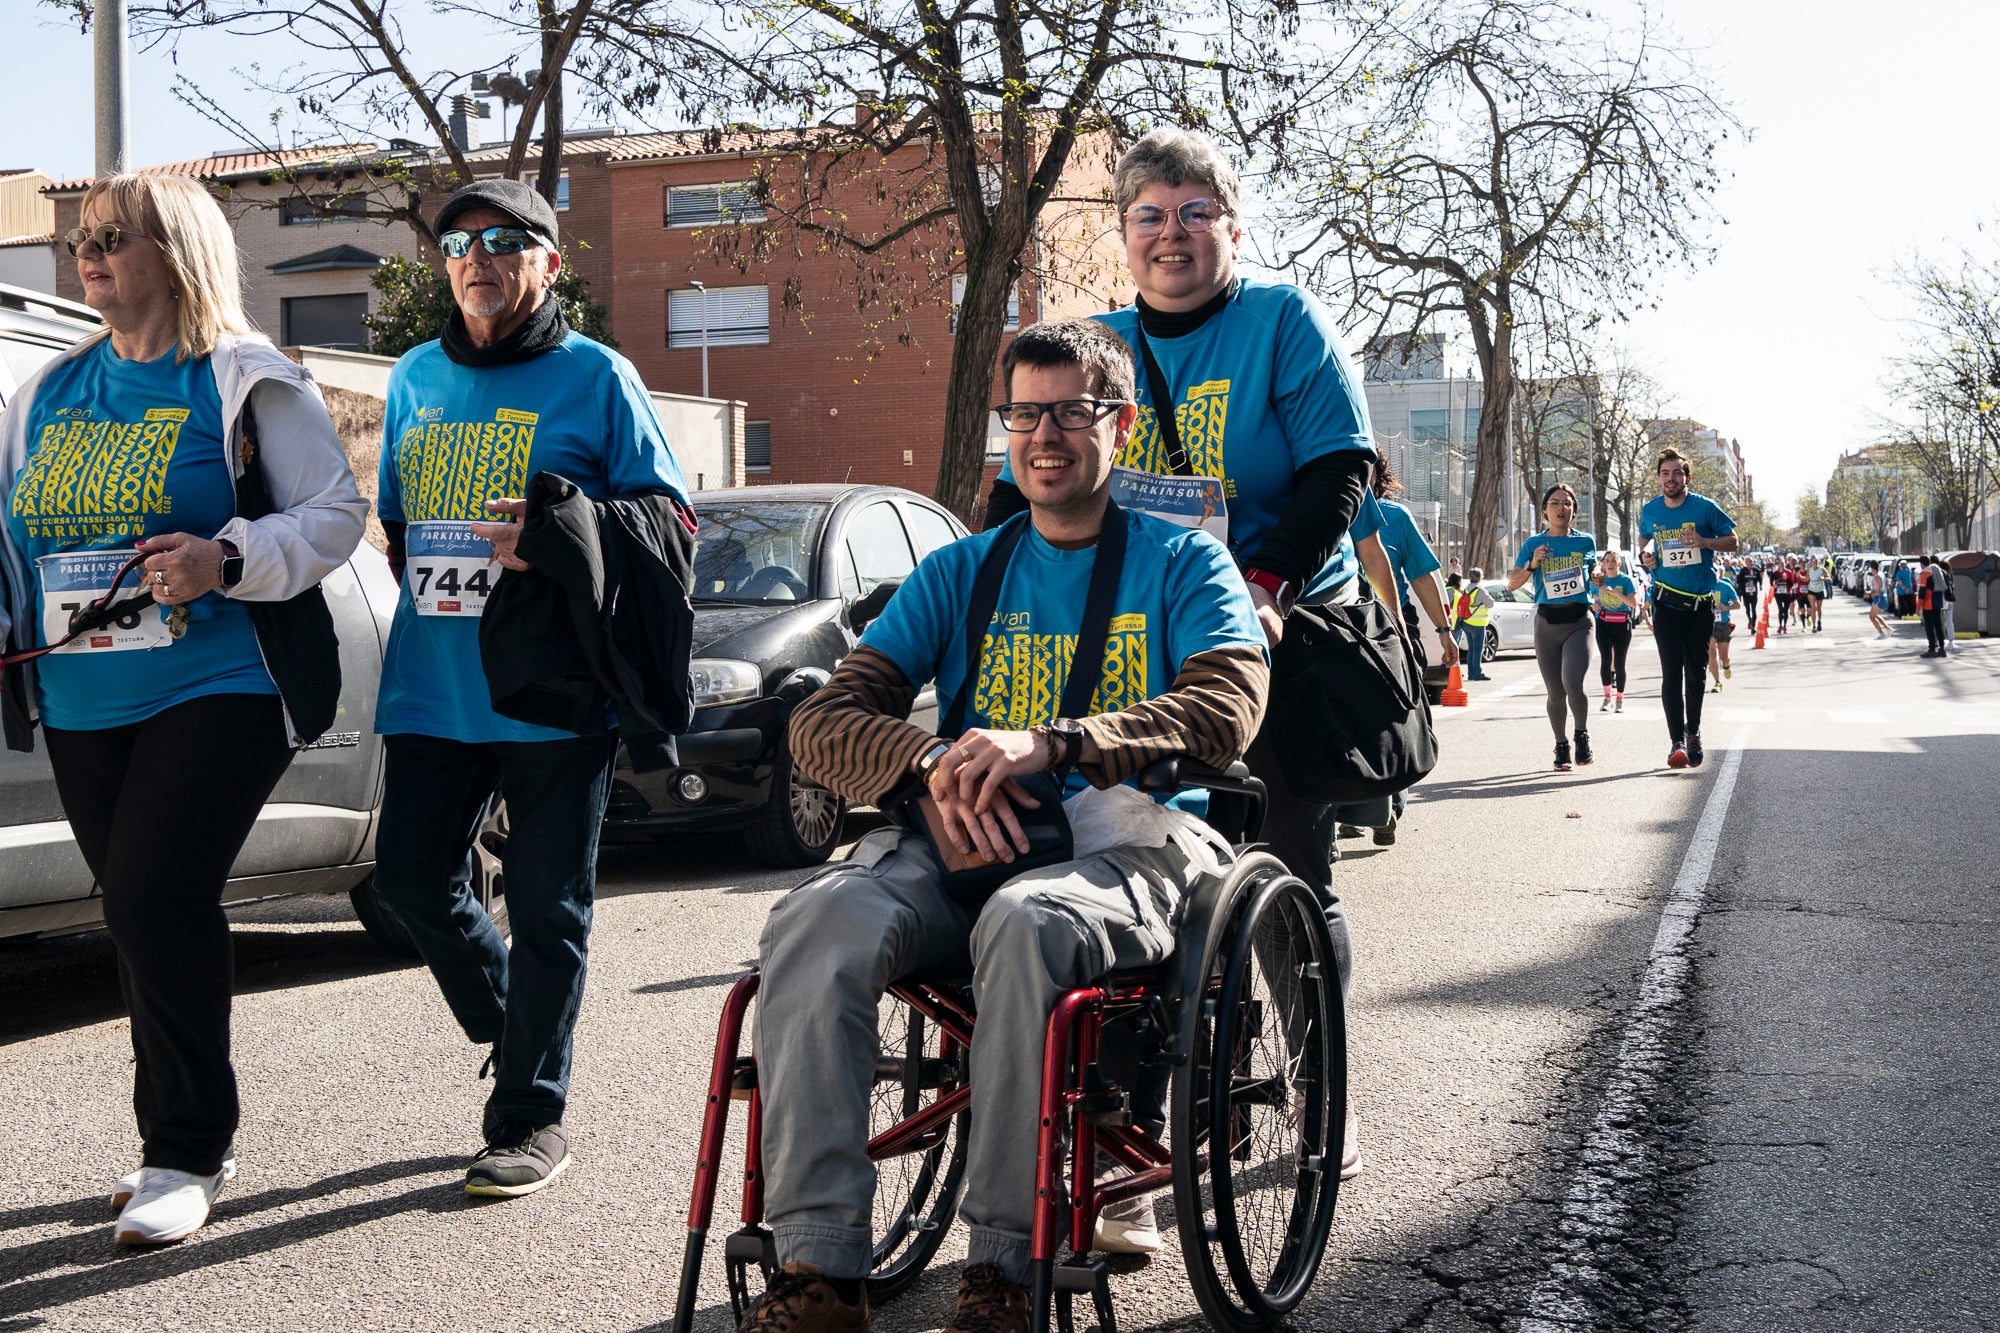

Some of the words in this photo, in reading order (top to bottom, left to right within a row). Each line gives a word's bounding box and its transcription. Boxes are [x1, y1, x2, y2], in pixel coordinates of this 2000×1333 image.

[1120, 479, 1204, 498] PARKINSON
[42, 517, 69, 525] CURSA
[77, 516, 126, 524] PASSEJADA
[128, 515, 144, 523] PEL
[29, 523, 145, 538] PARKINSON
[1670, 550, 1692, 561] 371
[60, 562, 127, 574] PARKINSO
[416, 567, 491, 597] 744
[1553, 580, 1578, 593] 370
[308, 731, 360, 748] NEGADE
